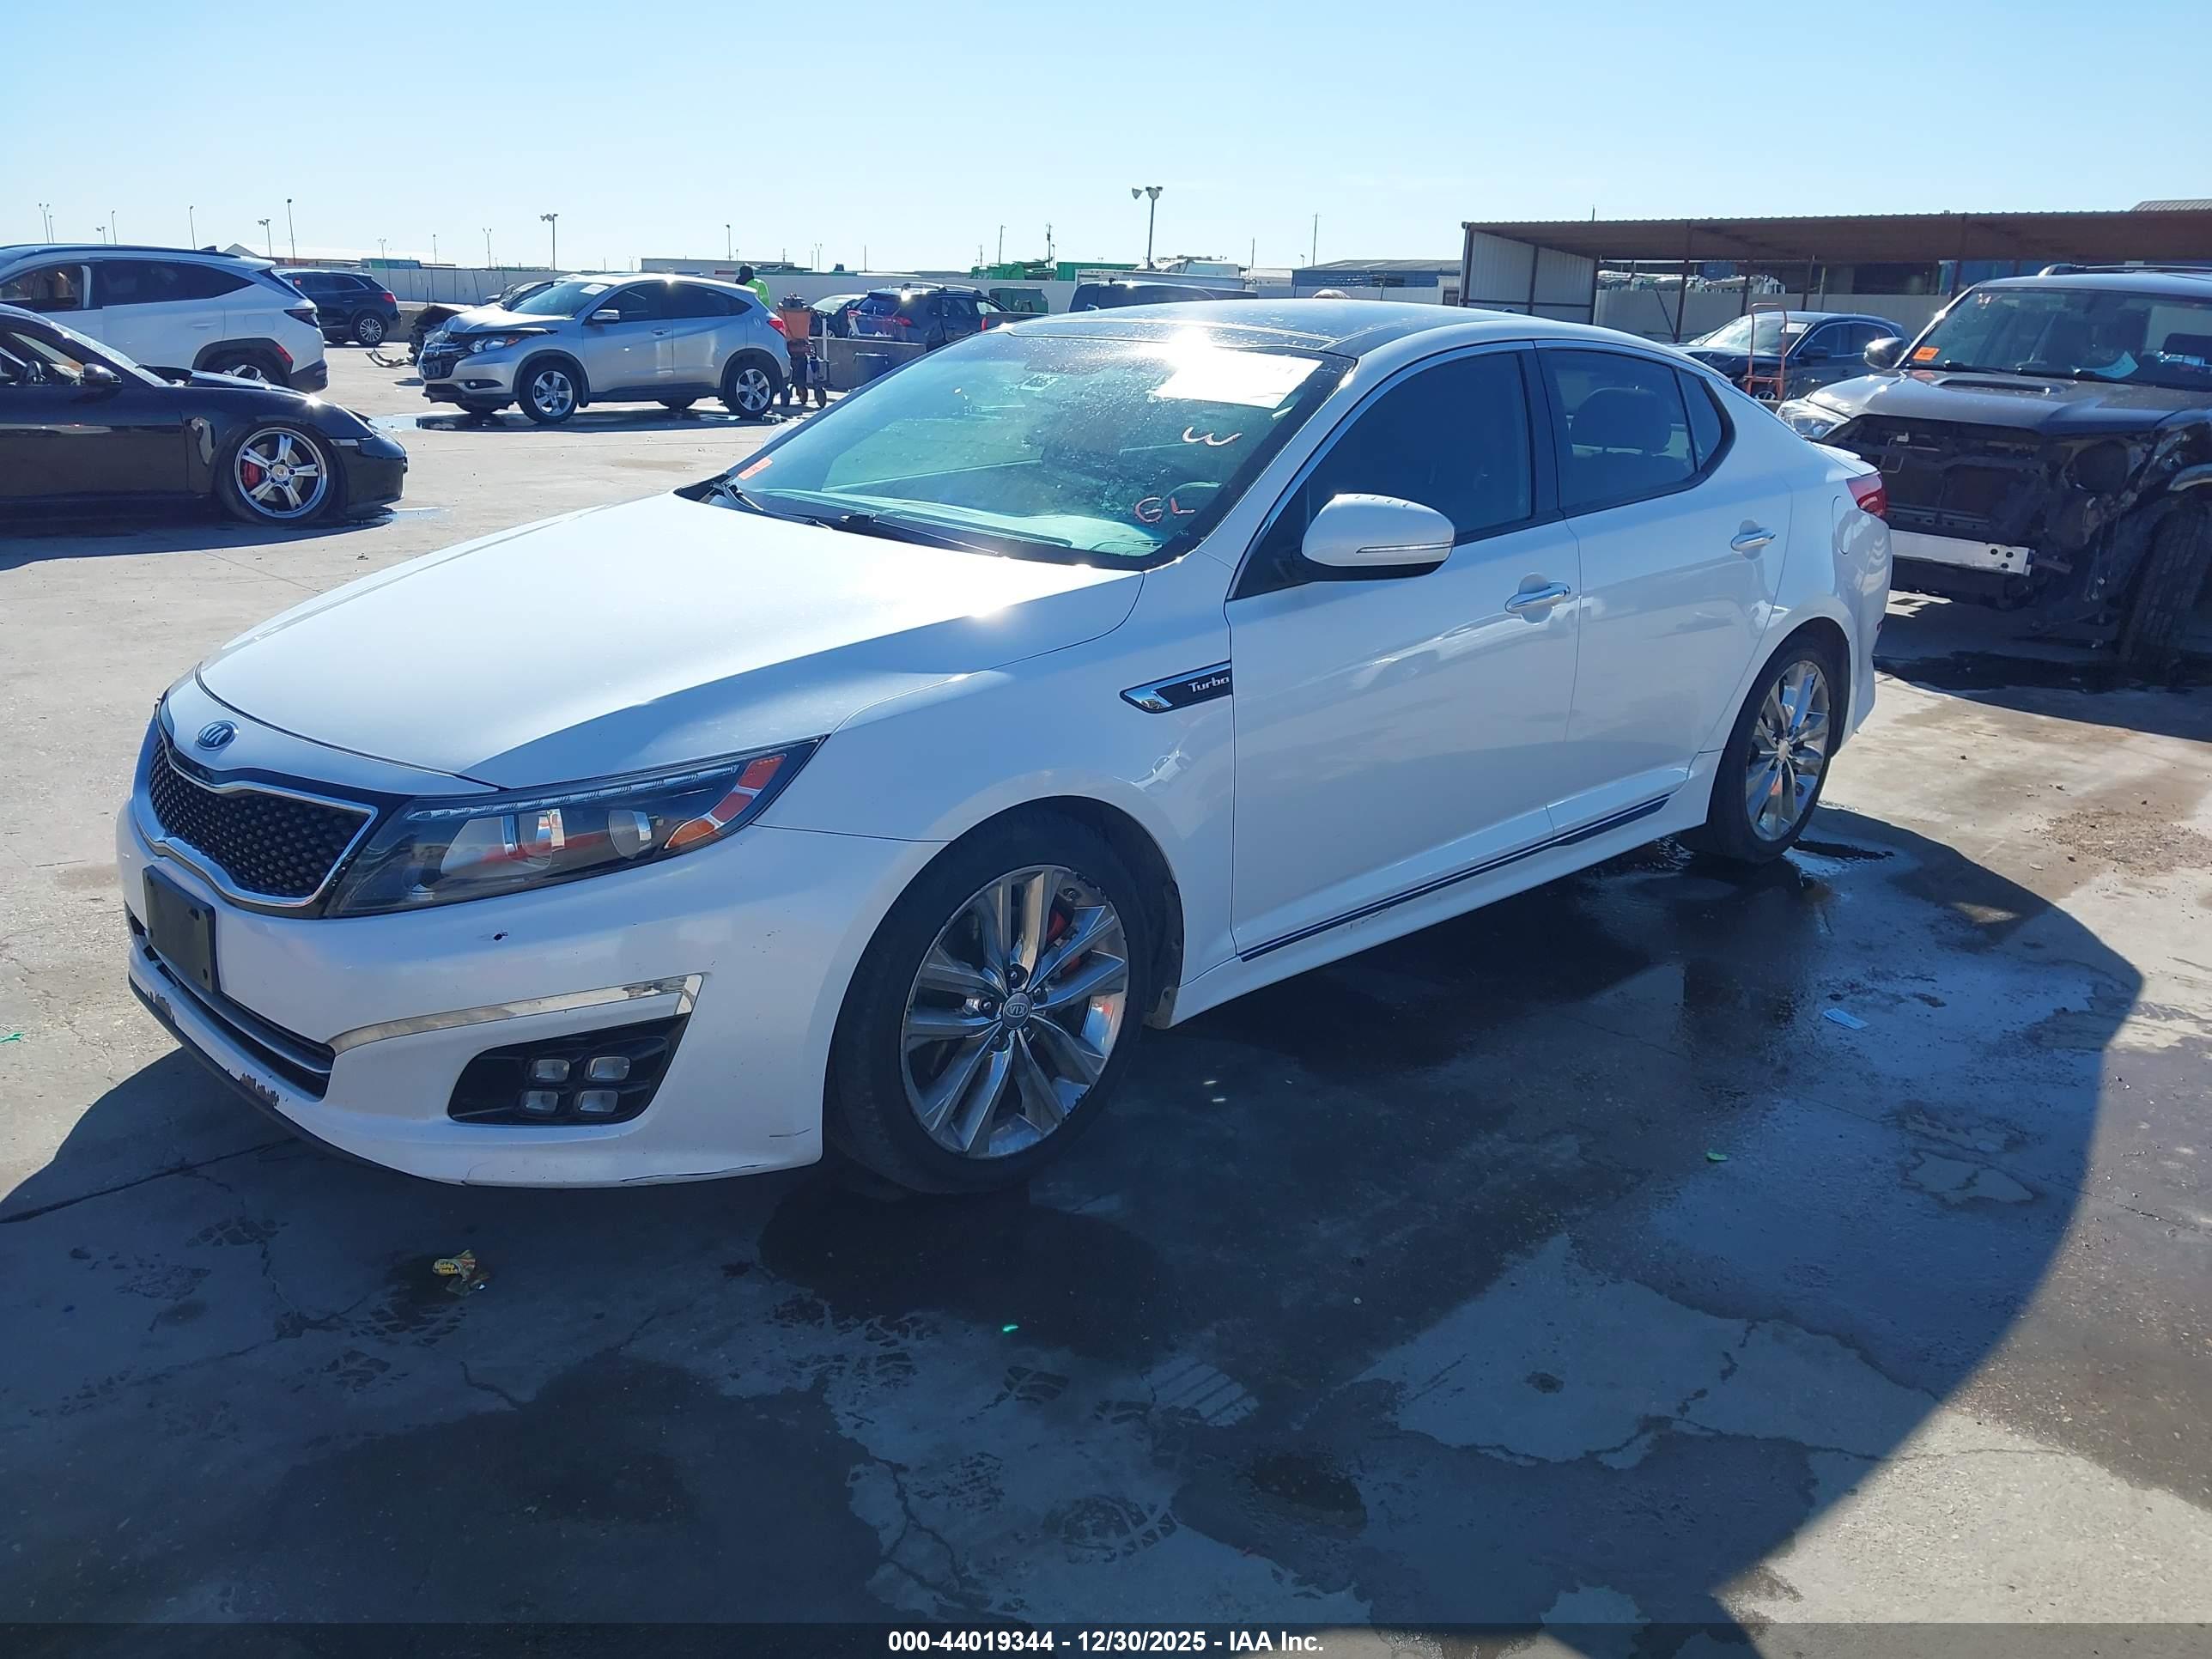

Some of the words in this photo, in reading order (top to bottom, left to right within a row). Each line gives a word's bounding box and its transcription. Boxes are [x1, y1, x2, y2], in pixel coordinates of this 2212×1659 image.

[1188, 676, 1230, 692] Turbo
[198, 723, 229, 745] KIA
[1007, 1005, 1026, 1016] KIA
